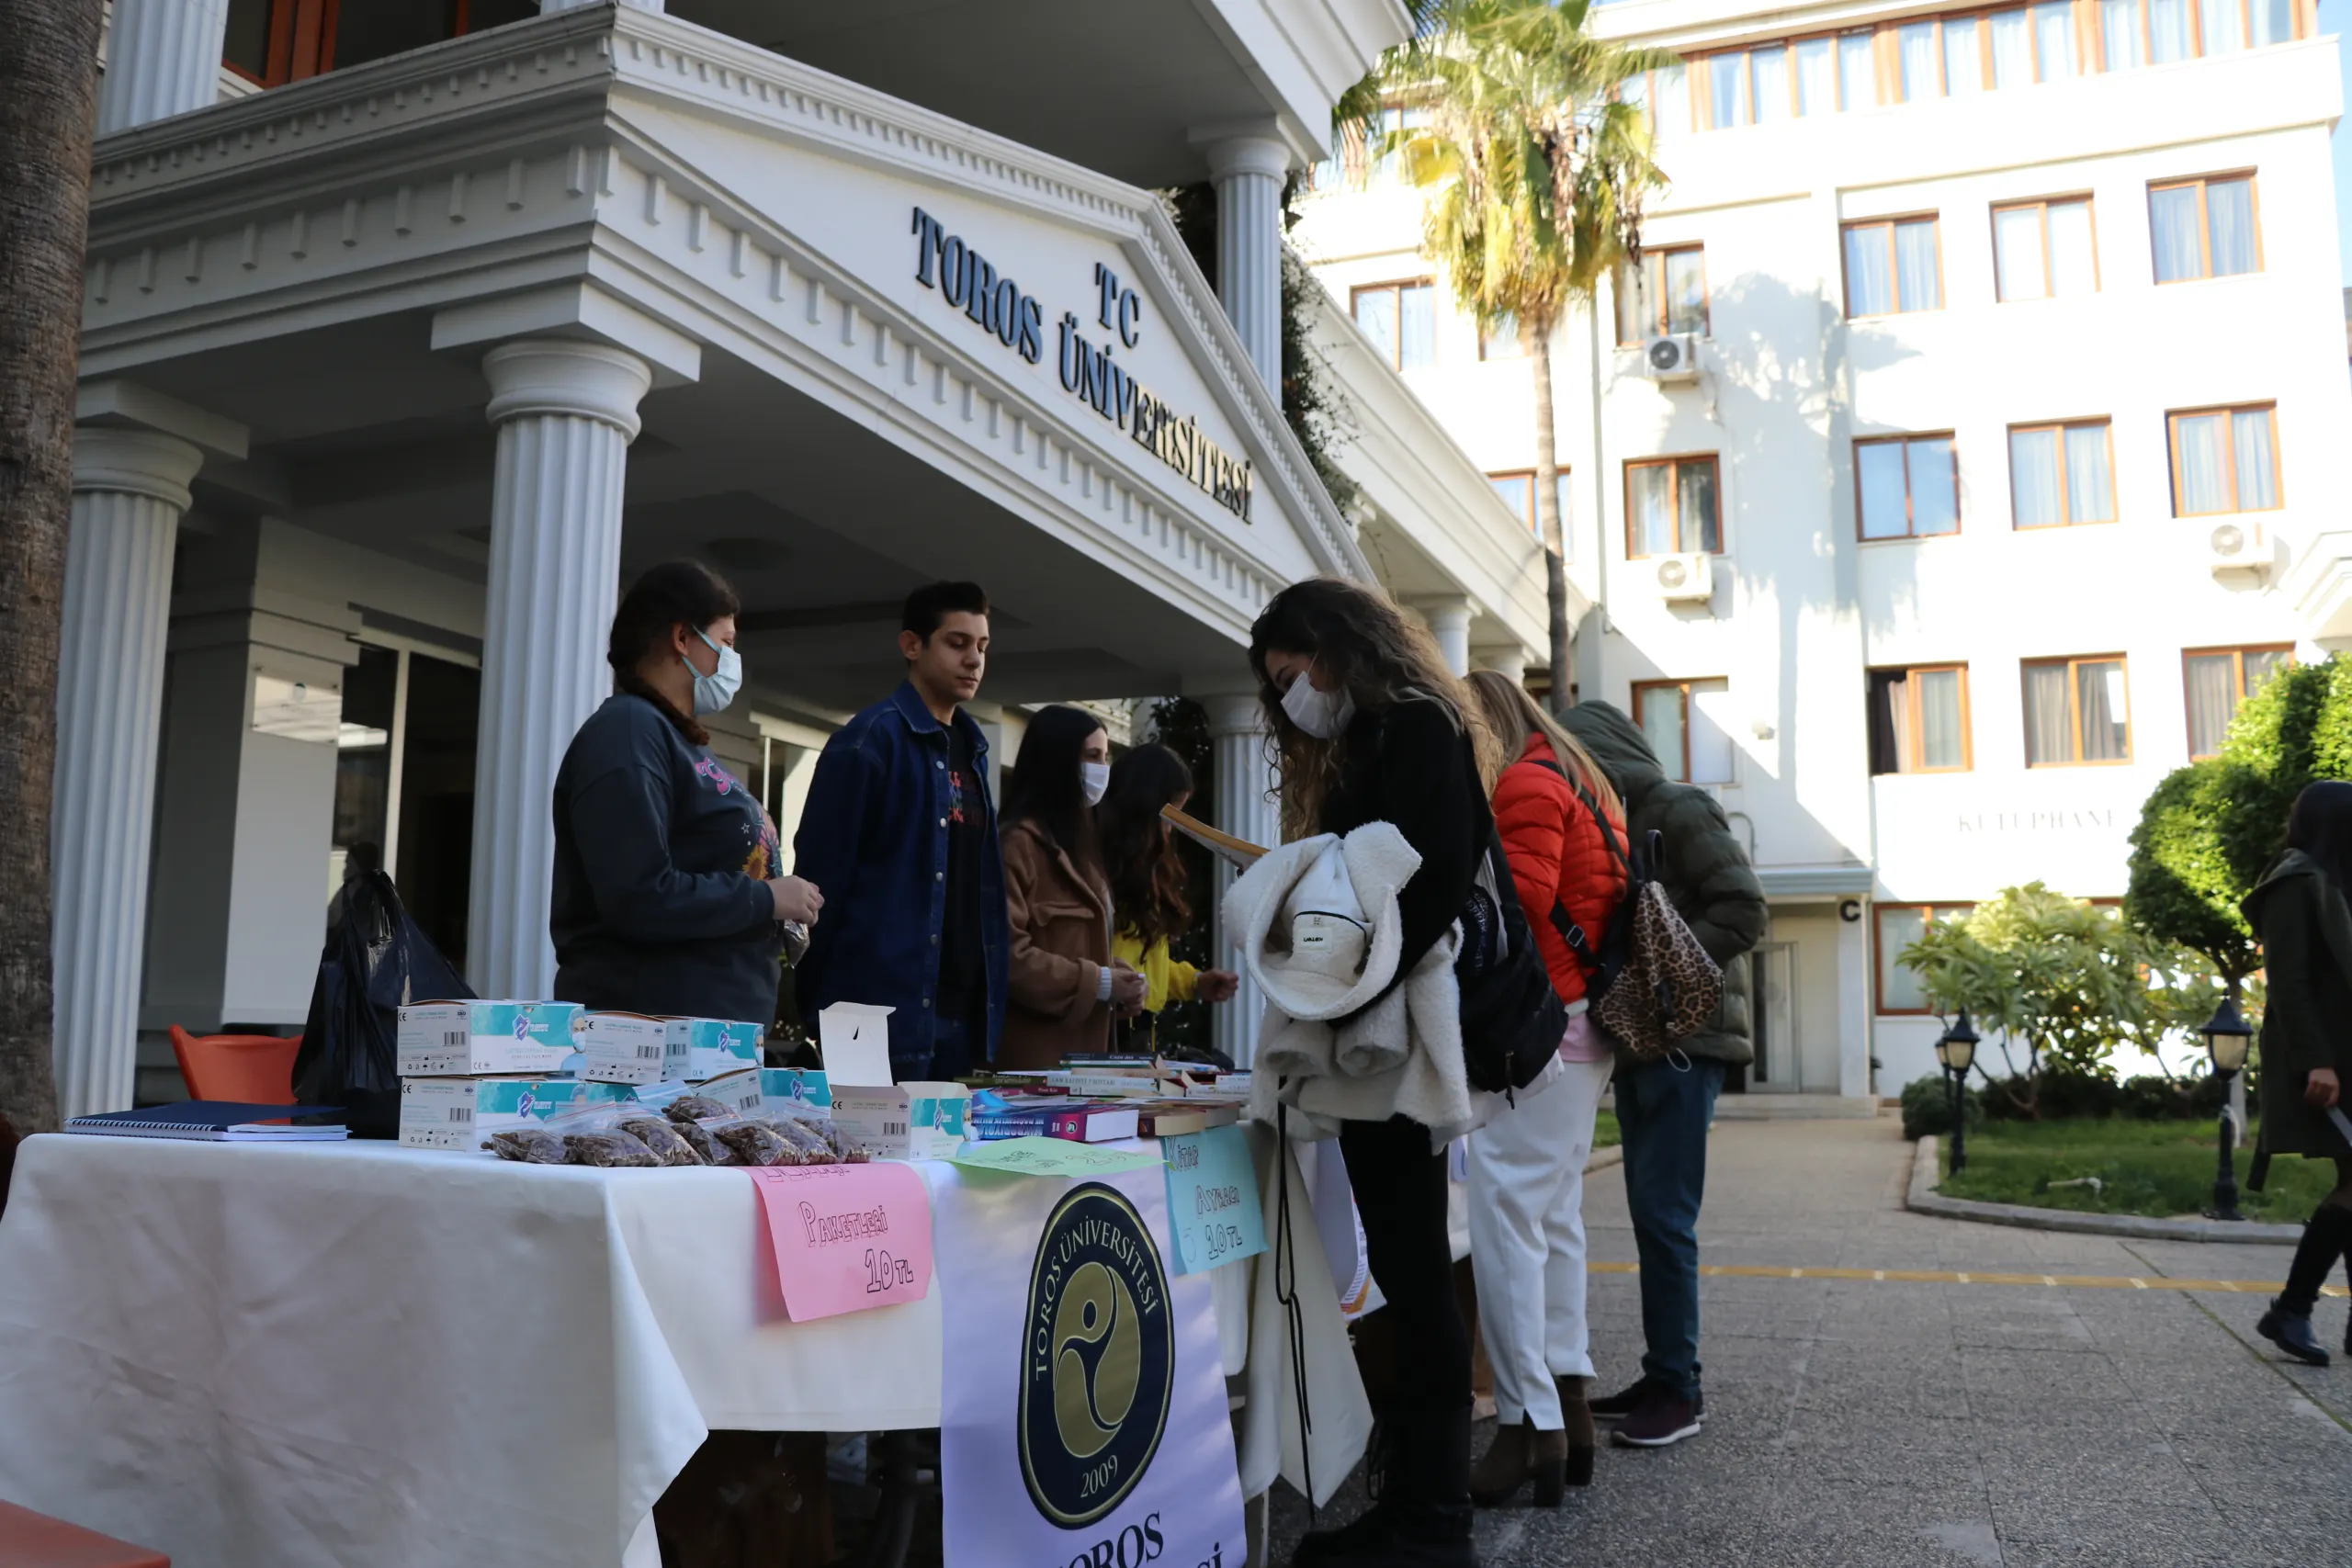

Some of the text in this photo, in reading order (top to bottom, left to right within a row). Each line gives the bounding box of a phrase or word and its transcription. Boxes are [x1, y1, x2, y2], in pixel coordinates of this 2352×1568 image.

[911, 206, 1253, 525] TOROS ÜNİVERSİTESİ
[1838, 899, 1862, 923] C
[1035, 1214, 1159, 1382] TOROS ÜNİVERSİTESİ
[1080, 1454, 1119, 1499] 2009
